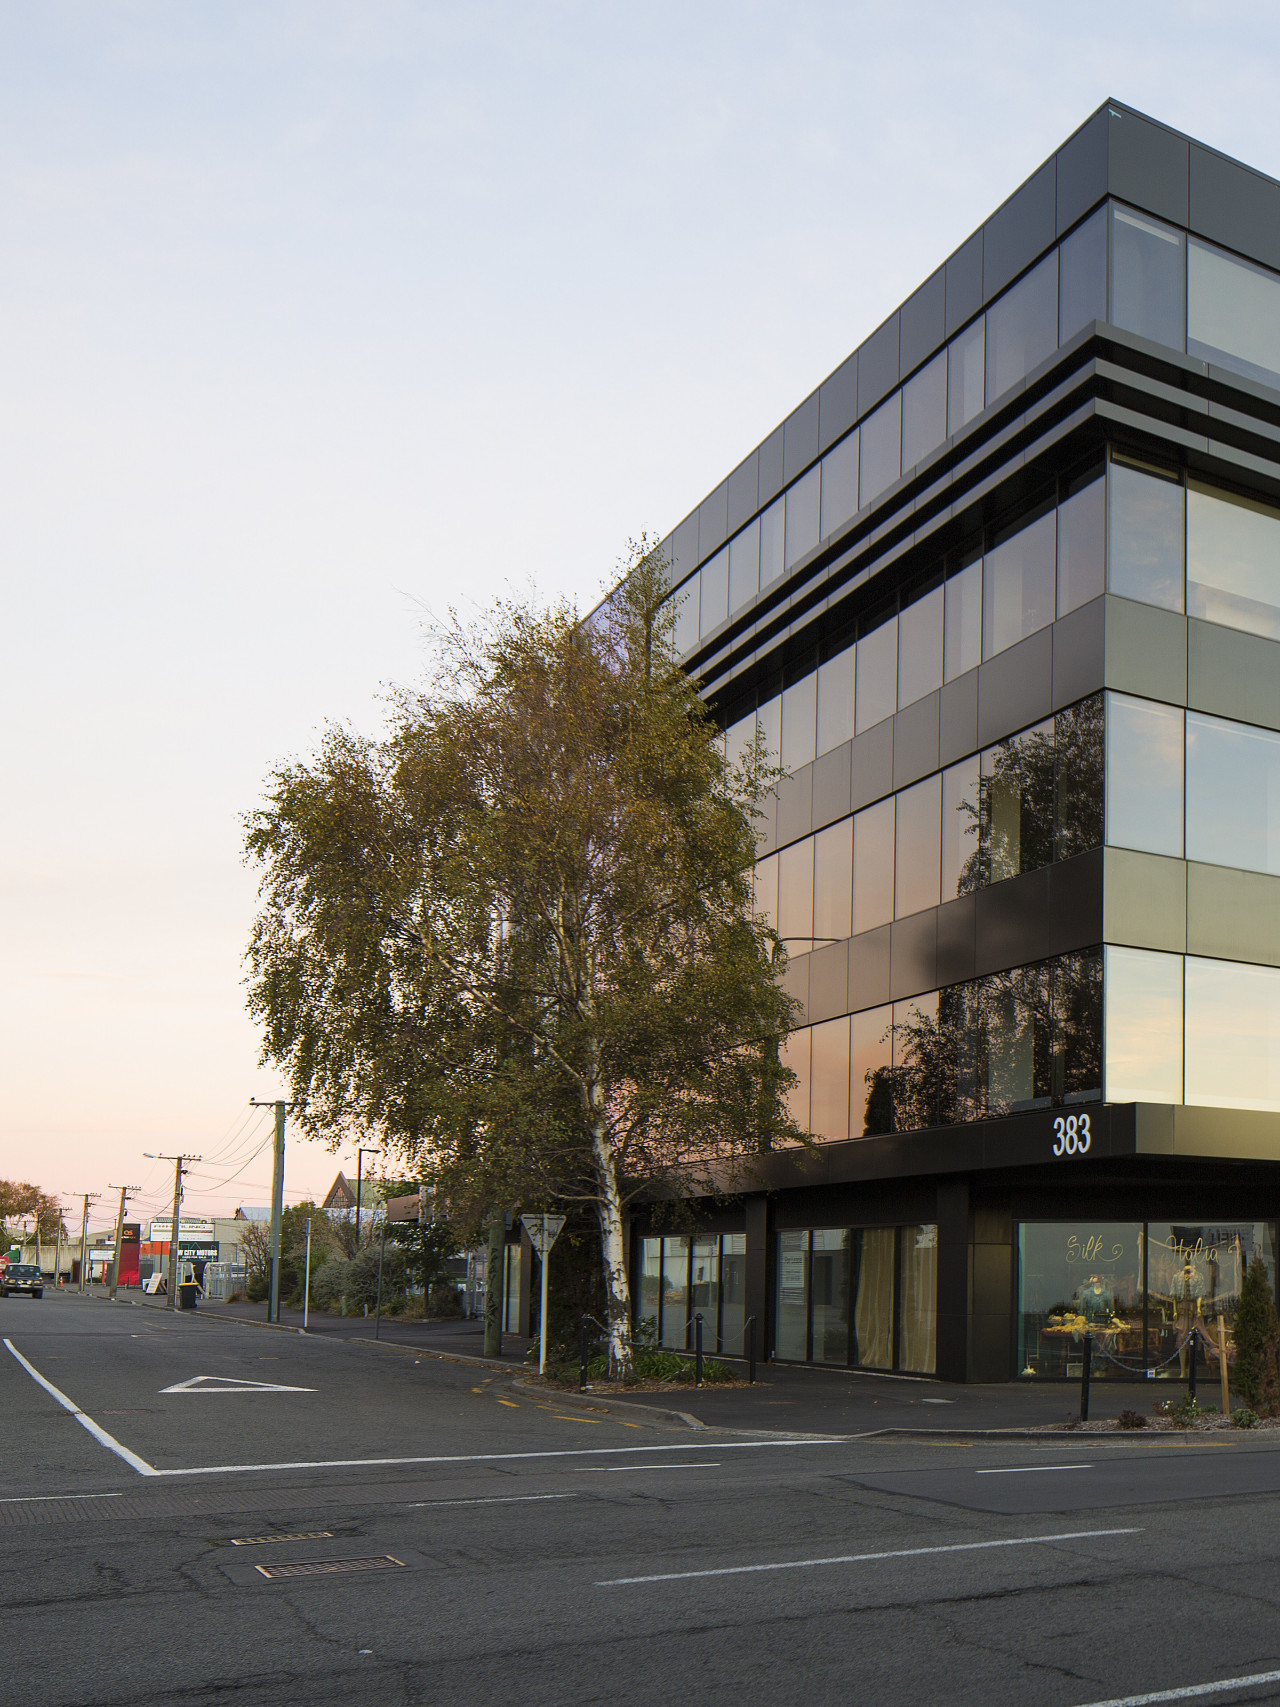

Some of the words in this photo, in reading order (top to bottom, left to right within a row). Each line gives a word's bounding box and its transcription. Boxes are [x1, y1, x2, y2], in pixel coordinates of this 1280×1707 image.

[1052, 1113, 1091, 1157] 383
[1065, 1234, 1124, 1263] Silk
[1164, 1234, 1238, 1266] Italia
